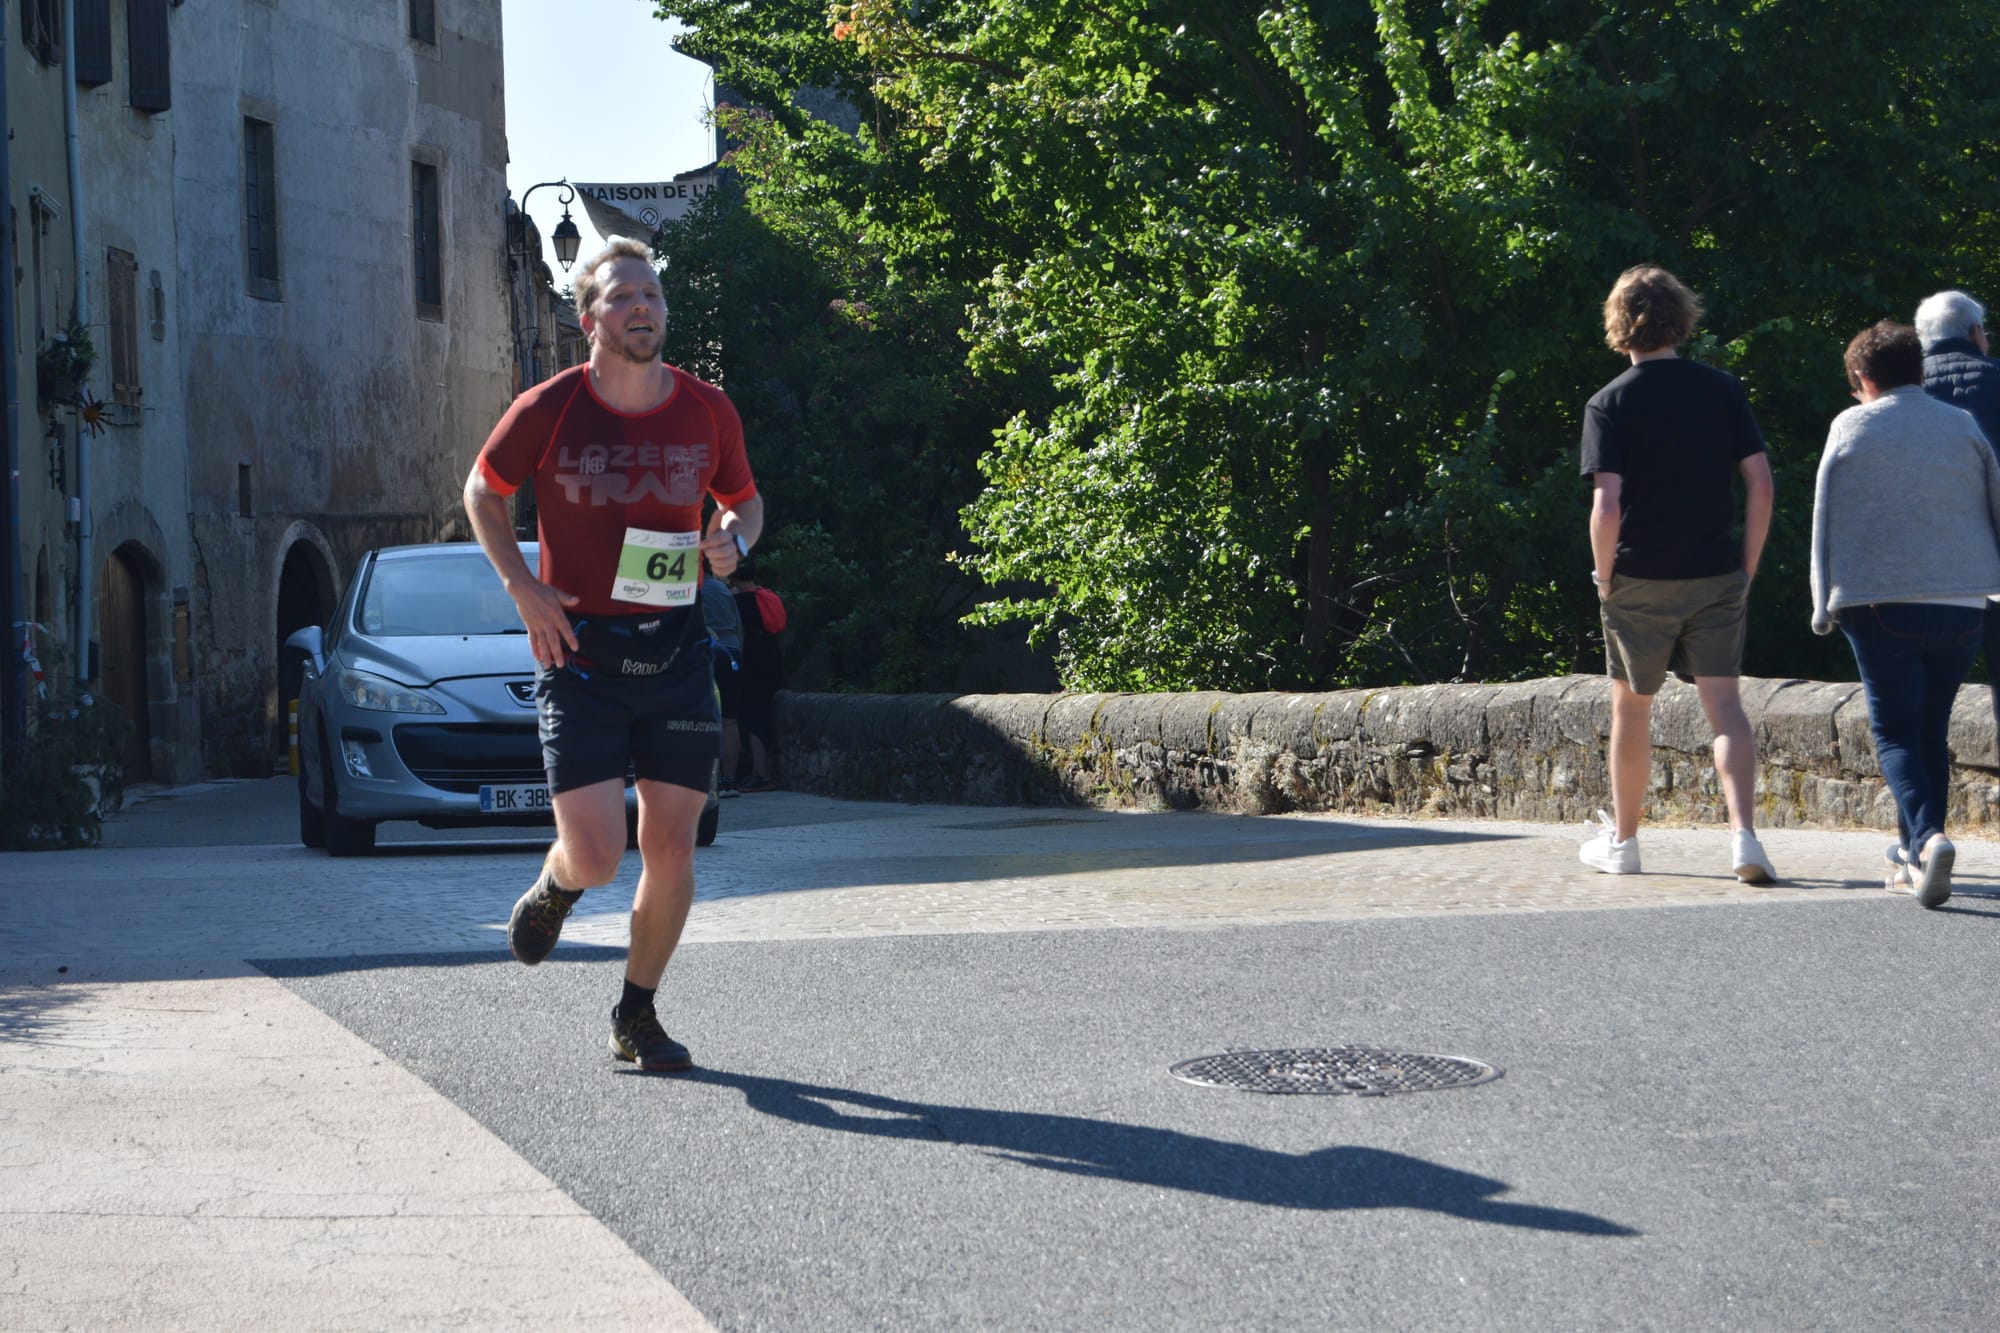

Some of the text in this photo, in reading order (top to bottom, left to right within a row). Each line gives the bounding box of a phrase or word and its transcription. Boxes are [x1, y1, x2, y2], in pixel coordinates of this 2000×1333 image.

[580, 186, 657, 201] MAISON
[663, 184, 688, 199] DE
[646, 551, 686, 581] 64
